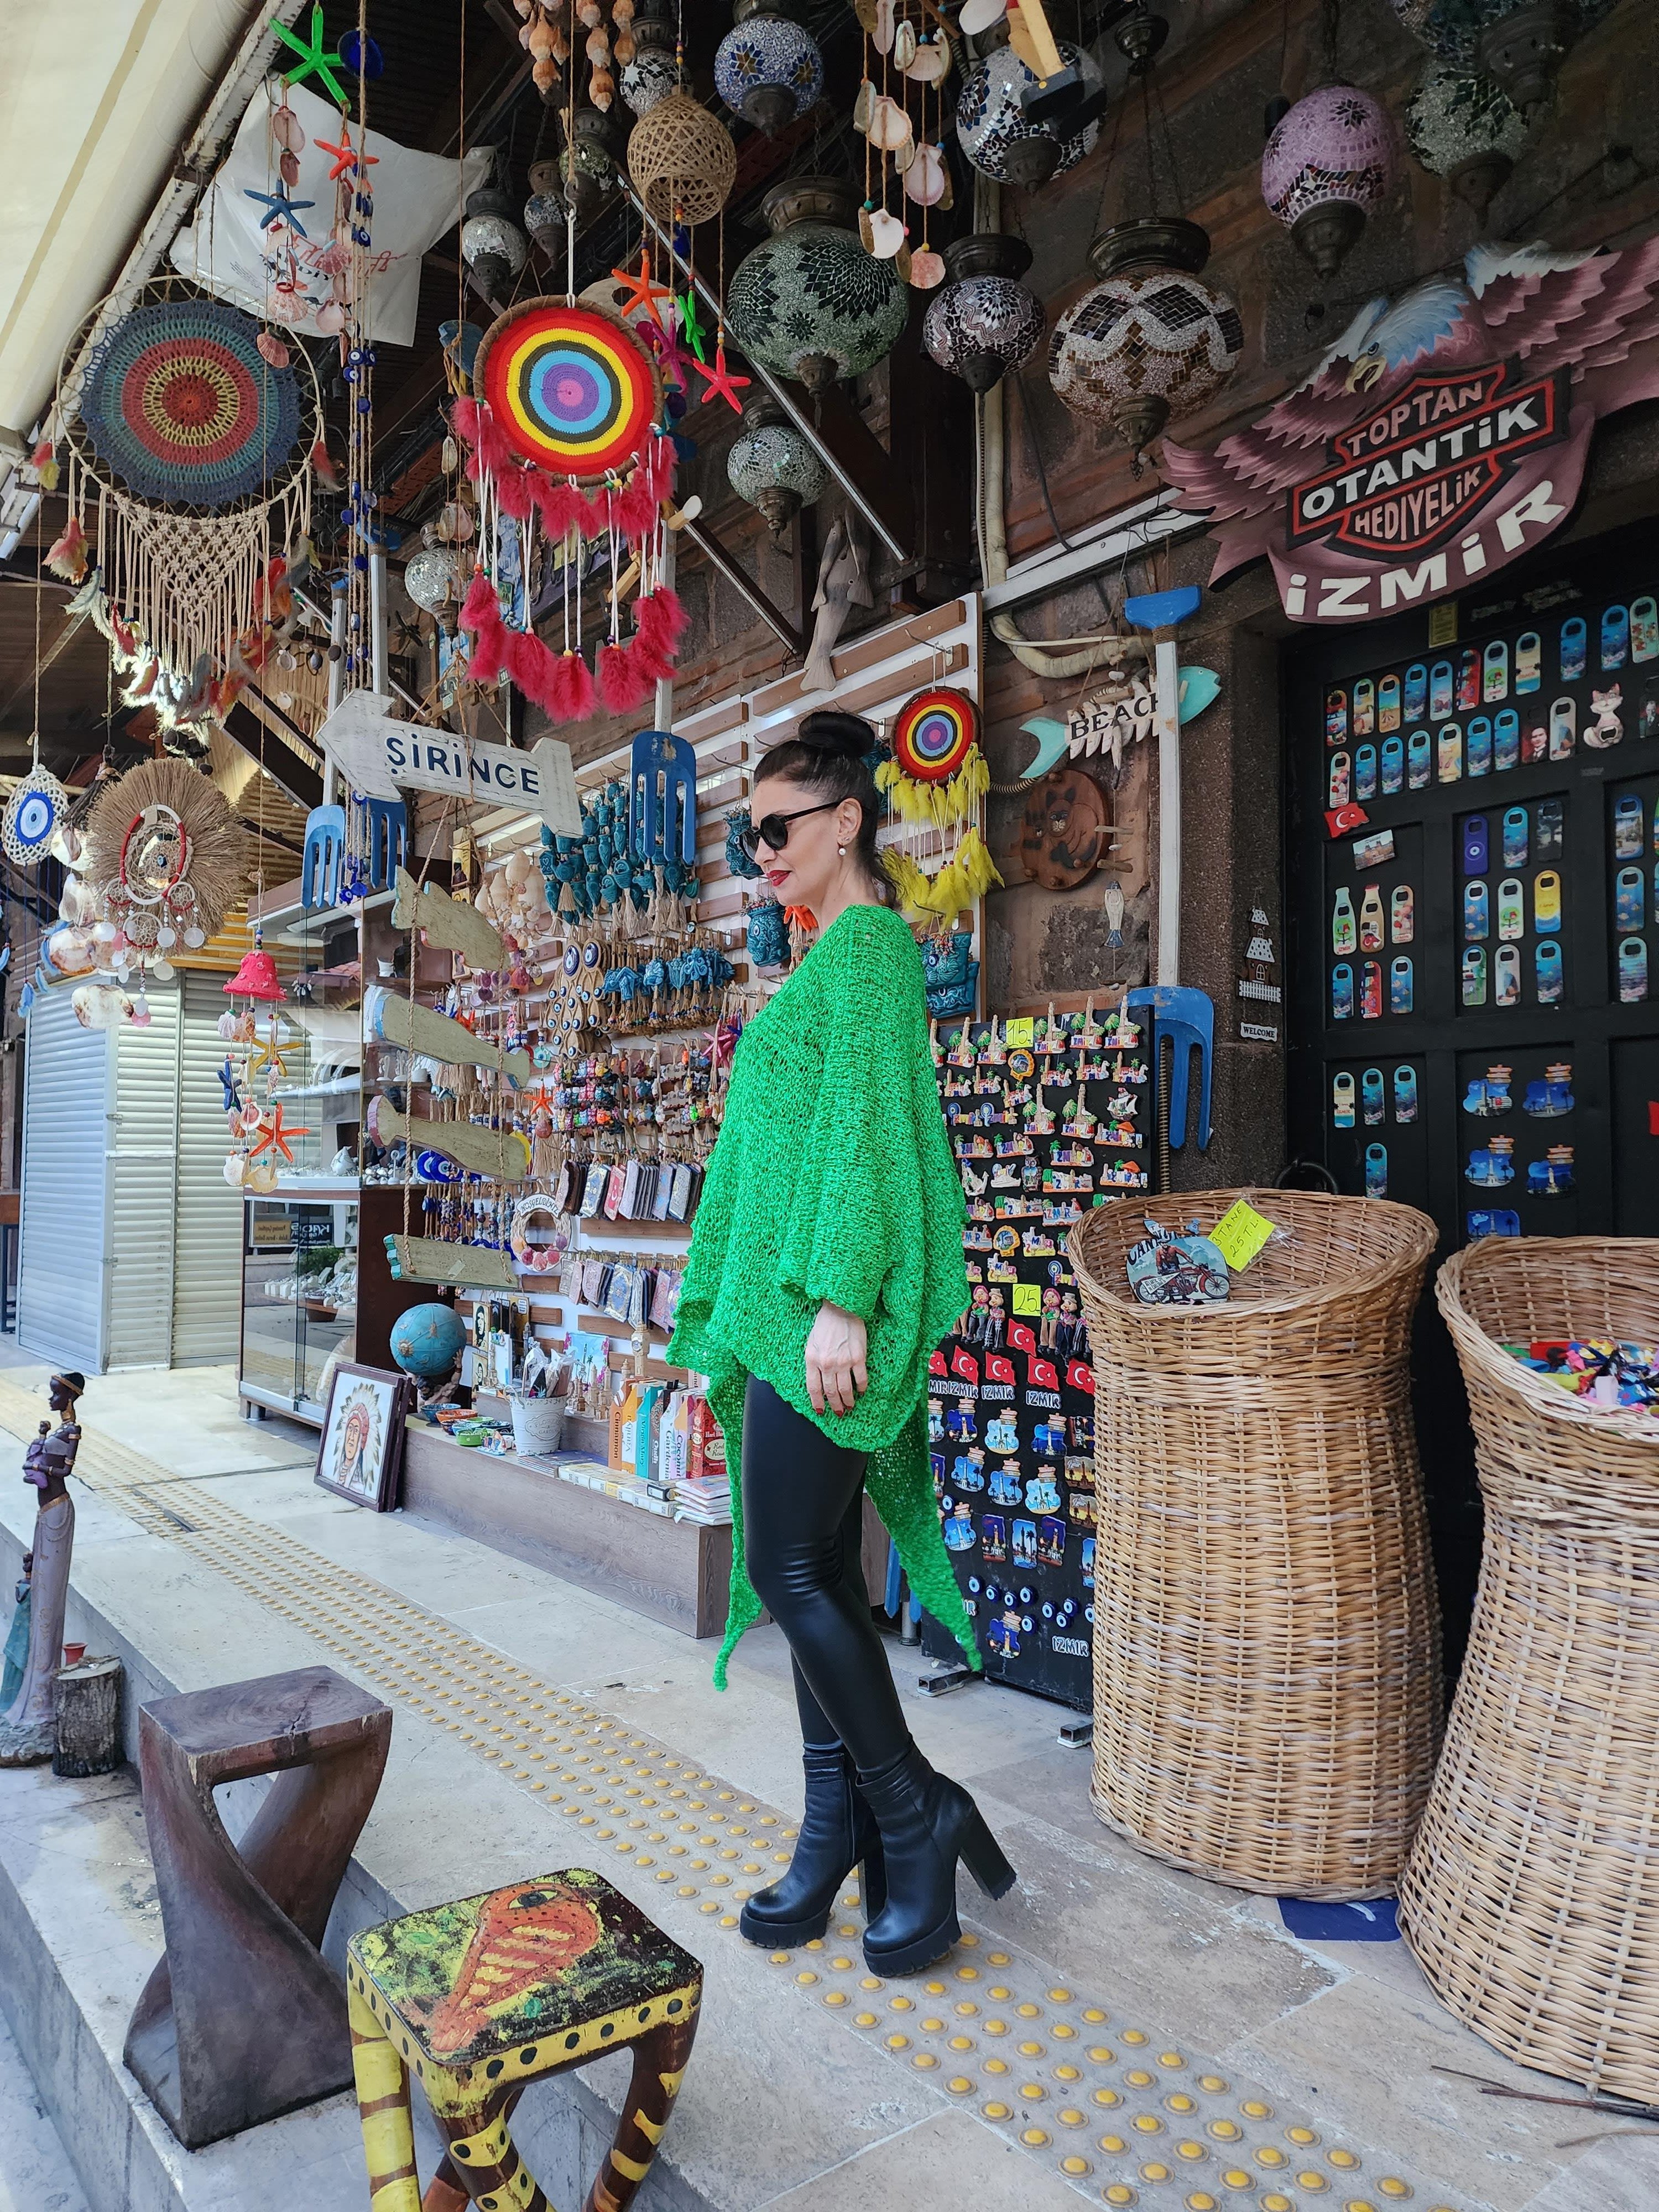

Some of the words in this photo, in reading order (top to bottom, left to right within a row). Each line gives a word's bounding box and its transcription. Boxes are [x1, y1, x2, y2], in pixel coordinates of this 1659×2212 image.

[1347, 381, 1483, 457] TOPTAN
[1007, 1019, 1029, 1047] 15
[1243, 1026, 1275, 1038] WELCOME
[1212, 1237, 1222, 1247] 3
[1218, 1206, 1241, 1237] TANE
[1230, 1235, 1244, 1258] 25
[1014, 1286, 1037, 1312] 25
[981, 1385, 1015, 1400] IZMIR
[1026, 1390, 1062, 1408] IZMIR
[1052, 1635, 1089, 1657] IZMIR
